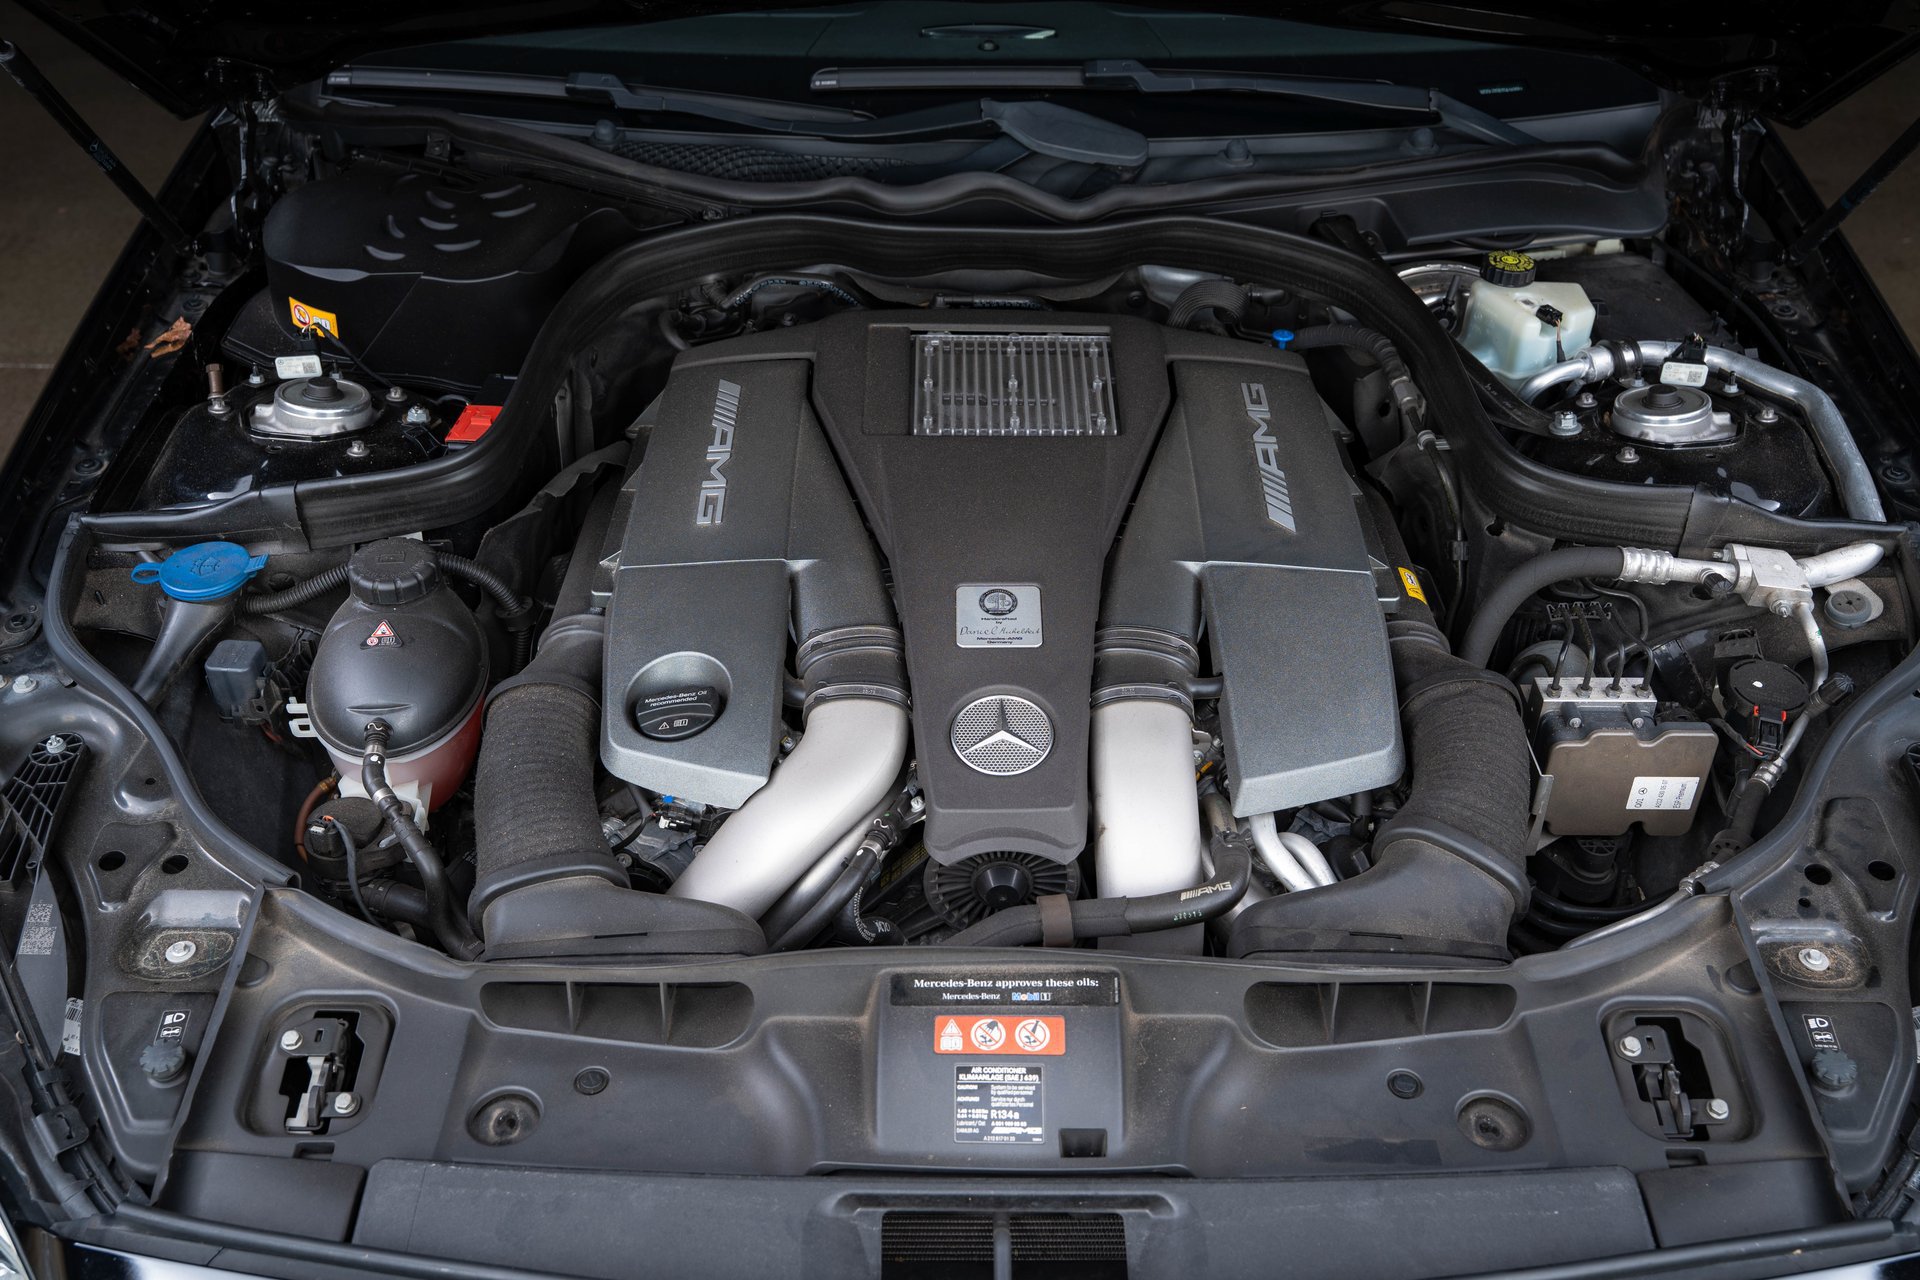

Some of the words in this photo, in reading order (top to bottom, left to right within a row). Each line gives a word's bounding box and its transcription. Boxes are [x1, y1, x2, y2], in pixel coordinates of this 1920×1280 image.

[1240, 382, 1285, 479] AMG
[696, 418, 735, 525] AMG
[644, 692, 696, 703] Mercedes-Benz
[650, 696, 698, 707] recommended
[914, 979, 993, 988] Mercedes-Benz
[995, 980, 1043, 989] approves
[1046, 979, 1074, 987] these
[1077, 978, 1099, 987] oils:
[1012, 992, 1040, 1000] Mobil
[991, 1110, 1019, 1119] R134a
